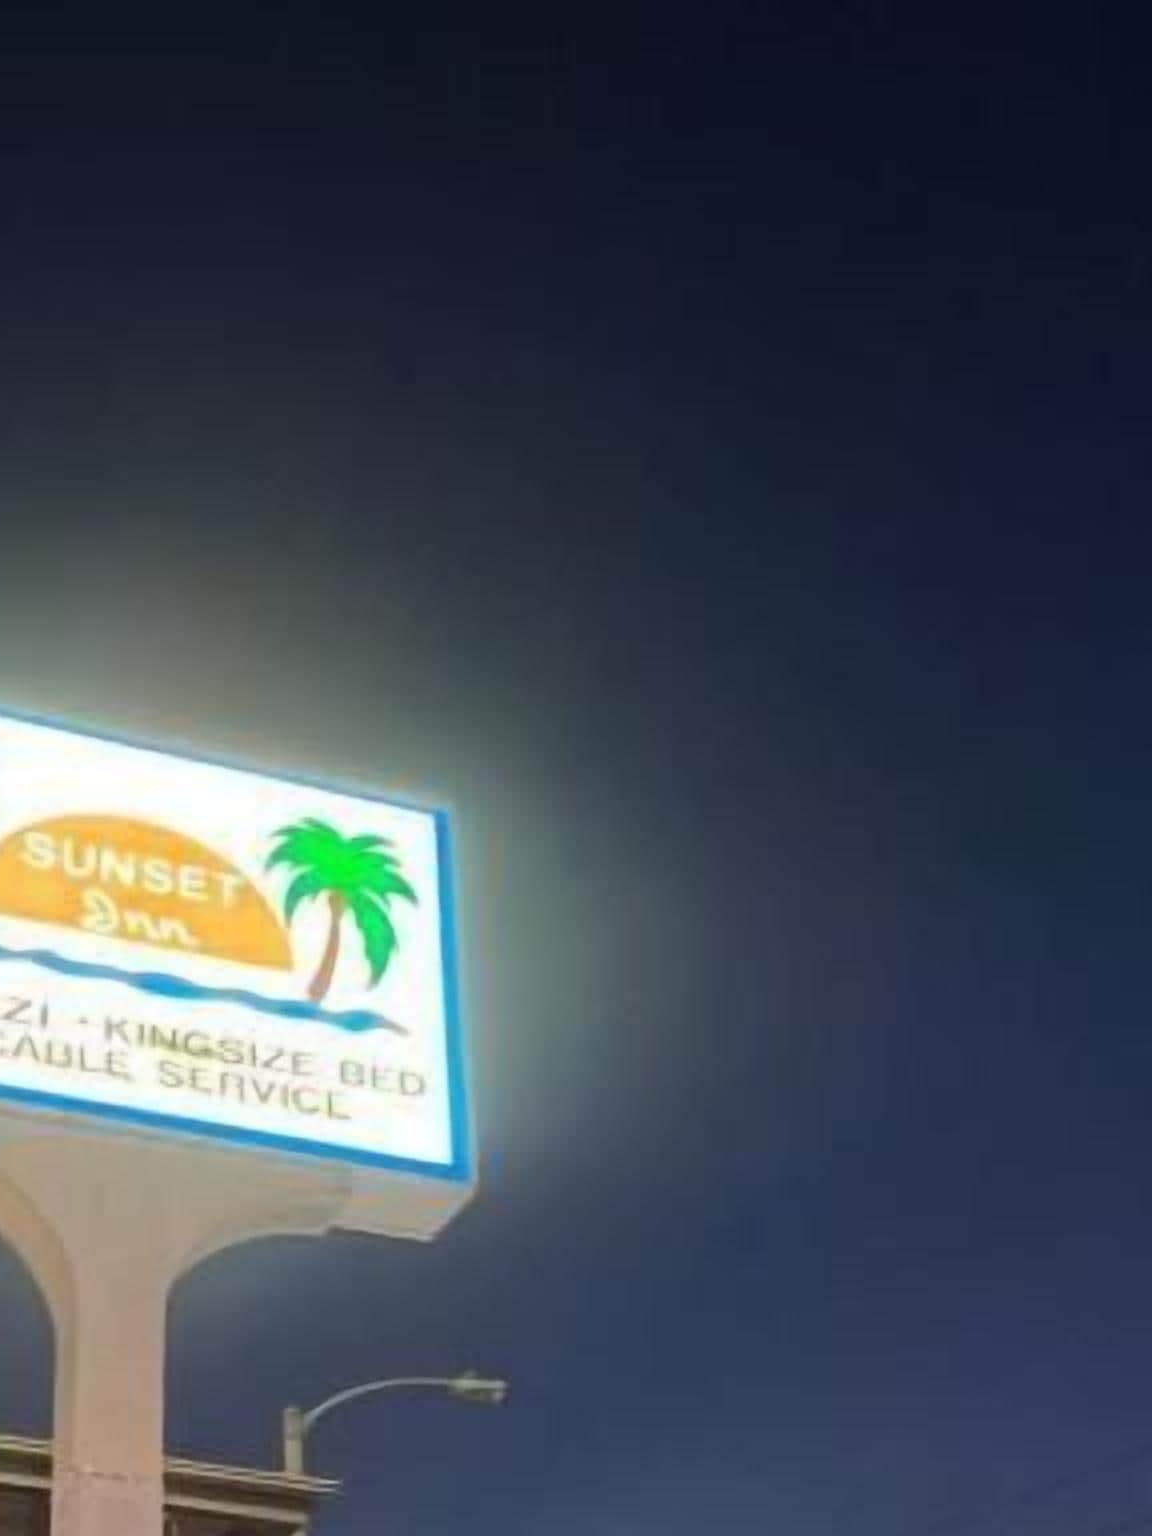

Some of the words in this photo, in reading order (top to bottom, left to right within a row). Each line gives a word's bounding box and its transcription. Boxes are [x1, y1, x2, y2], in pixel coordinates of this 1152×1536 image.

[22, 831, 246, 909] SUNSET
[81, 887, 199, 945] Inn
[104, 1017, 315, 1077] KINGSIZE
[340, 1060, 426, 1097] BED
